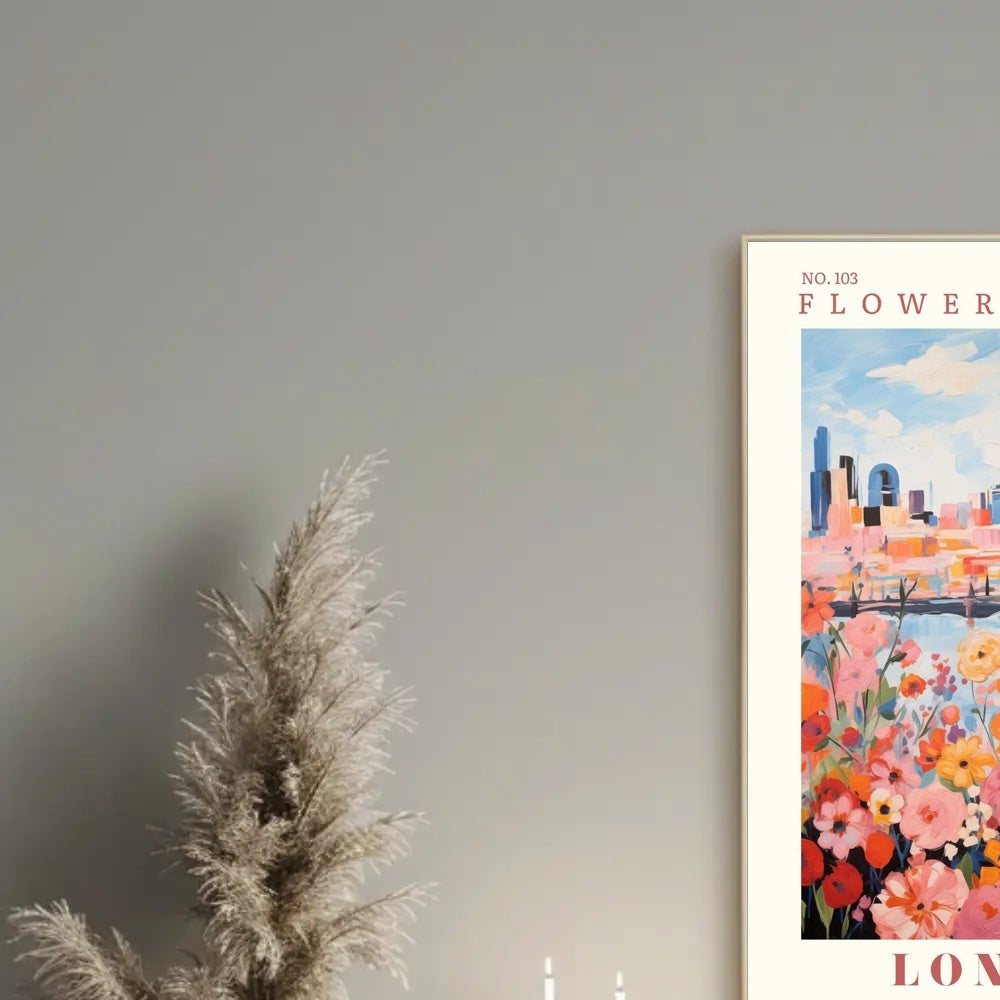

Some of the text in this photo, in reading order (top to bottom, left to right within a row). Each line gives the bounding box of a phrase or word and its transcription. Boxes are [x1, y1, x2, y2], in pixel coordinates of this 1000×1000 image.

[802, 272, 858, 285] NO. 103
[798, 292, 995, 315] FLOWER
